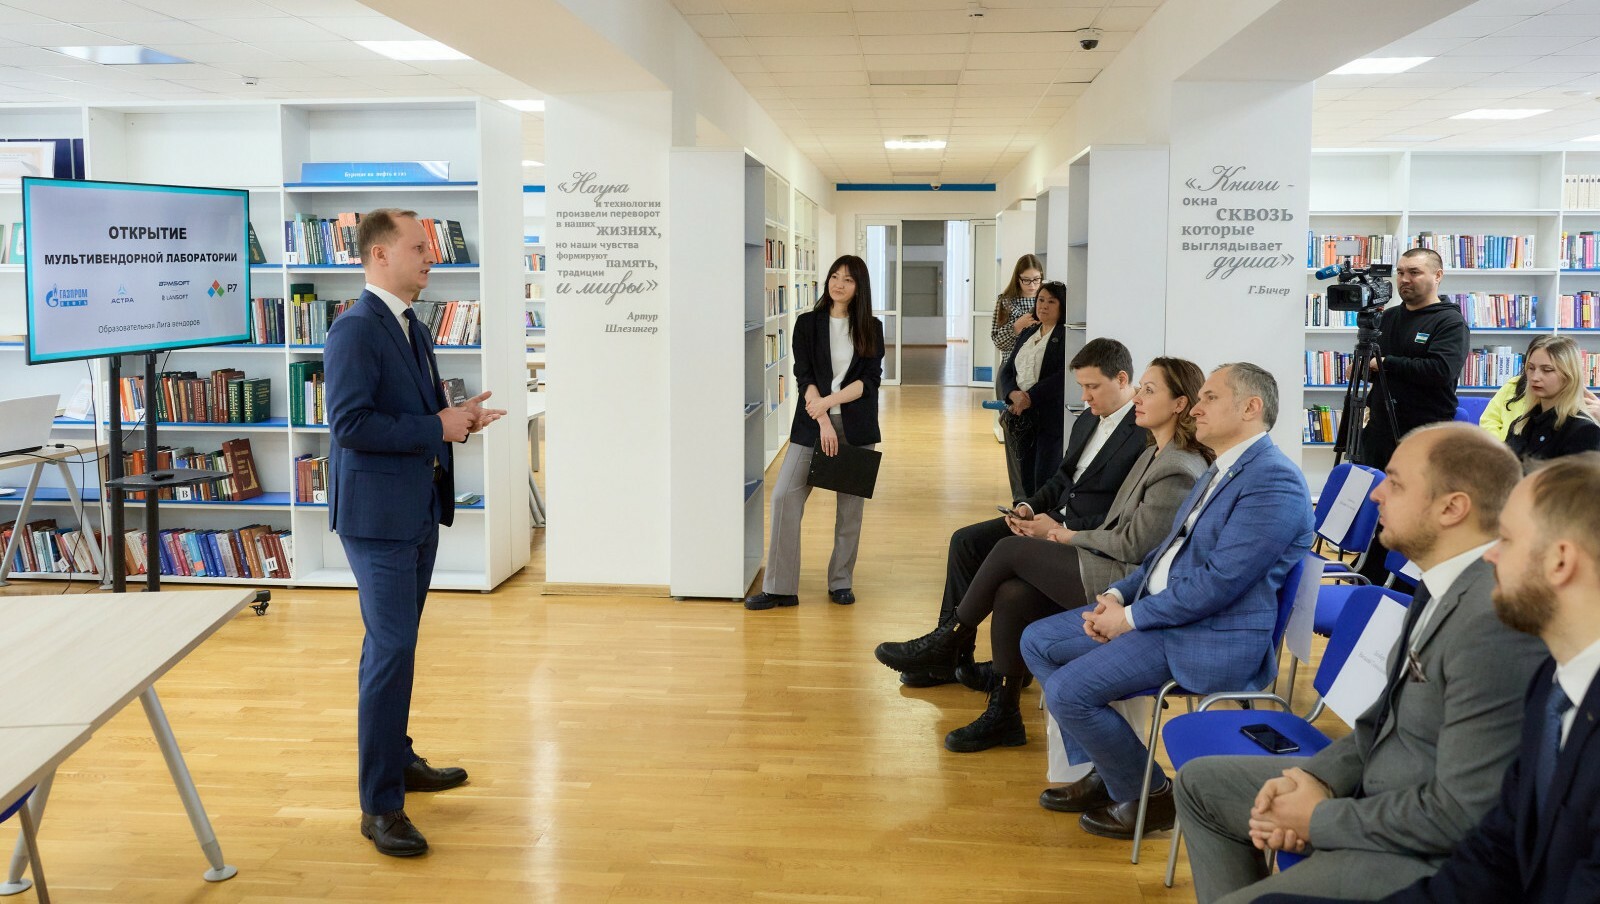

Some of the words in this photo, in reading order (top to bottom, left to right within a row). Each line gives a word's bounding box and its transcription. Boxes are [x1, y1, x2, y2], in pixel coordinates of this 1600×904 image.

[1185, 165, 1280, 192] «Книги
[557, 171, 629, 202] «Наука
[1182, 197, 1218, 206] окна
[556, 210, 607, 219] произвели
[610, 210, 661, 219] переворот
[1216, 207, 1294, 222] сквозь
[108, 225, 187, 240] ОТКРЫТИЕ
[596, 225, 662, 239] жизнях,
[1181, 225, 1255, 239] которые
[600, 242, 639, 251] чувства
[1182, 242, 1283, 252] выглядывает
[44, 251, 164, 266] МУЛЬТИВЕНДОРНОЙ
[166, 252, 238, 264] ЛАБОРАТОРИИ
[556, 251, 608, 261] формируют
[606, 259, 658, 271] память,
[1205, 253, 1295, 280] душа»
[557, 269, 604, 278] традиции
[59, 288, 88, 299] ГАЗПРОМ
[556, 282, 572, 294] и
[575, 269, 659, 306] мифы»
[1248, 285, 1291, 296] Г.Бичер
[626, 311, 659, 322] Артур
[98, 322, 156, 334] Образовательная
[156, 321, 171, 329] Лига
[605, 324, 658, 335] Шлезингер
